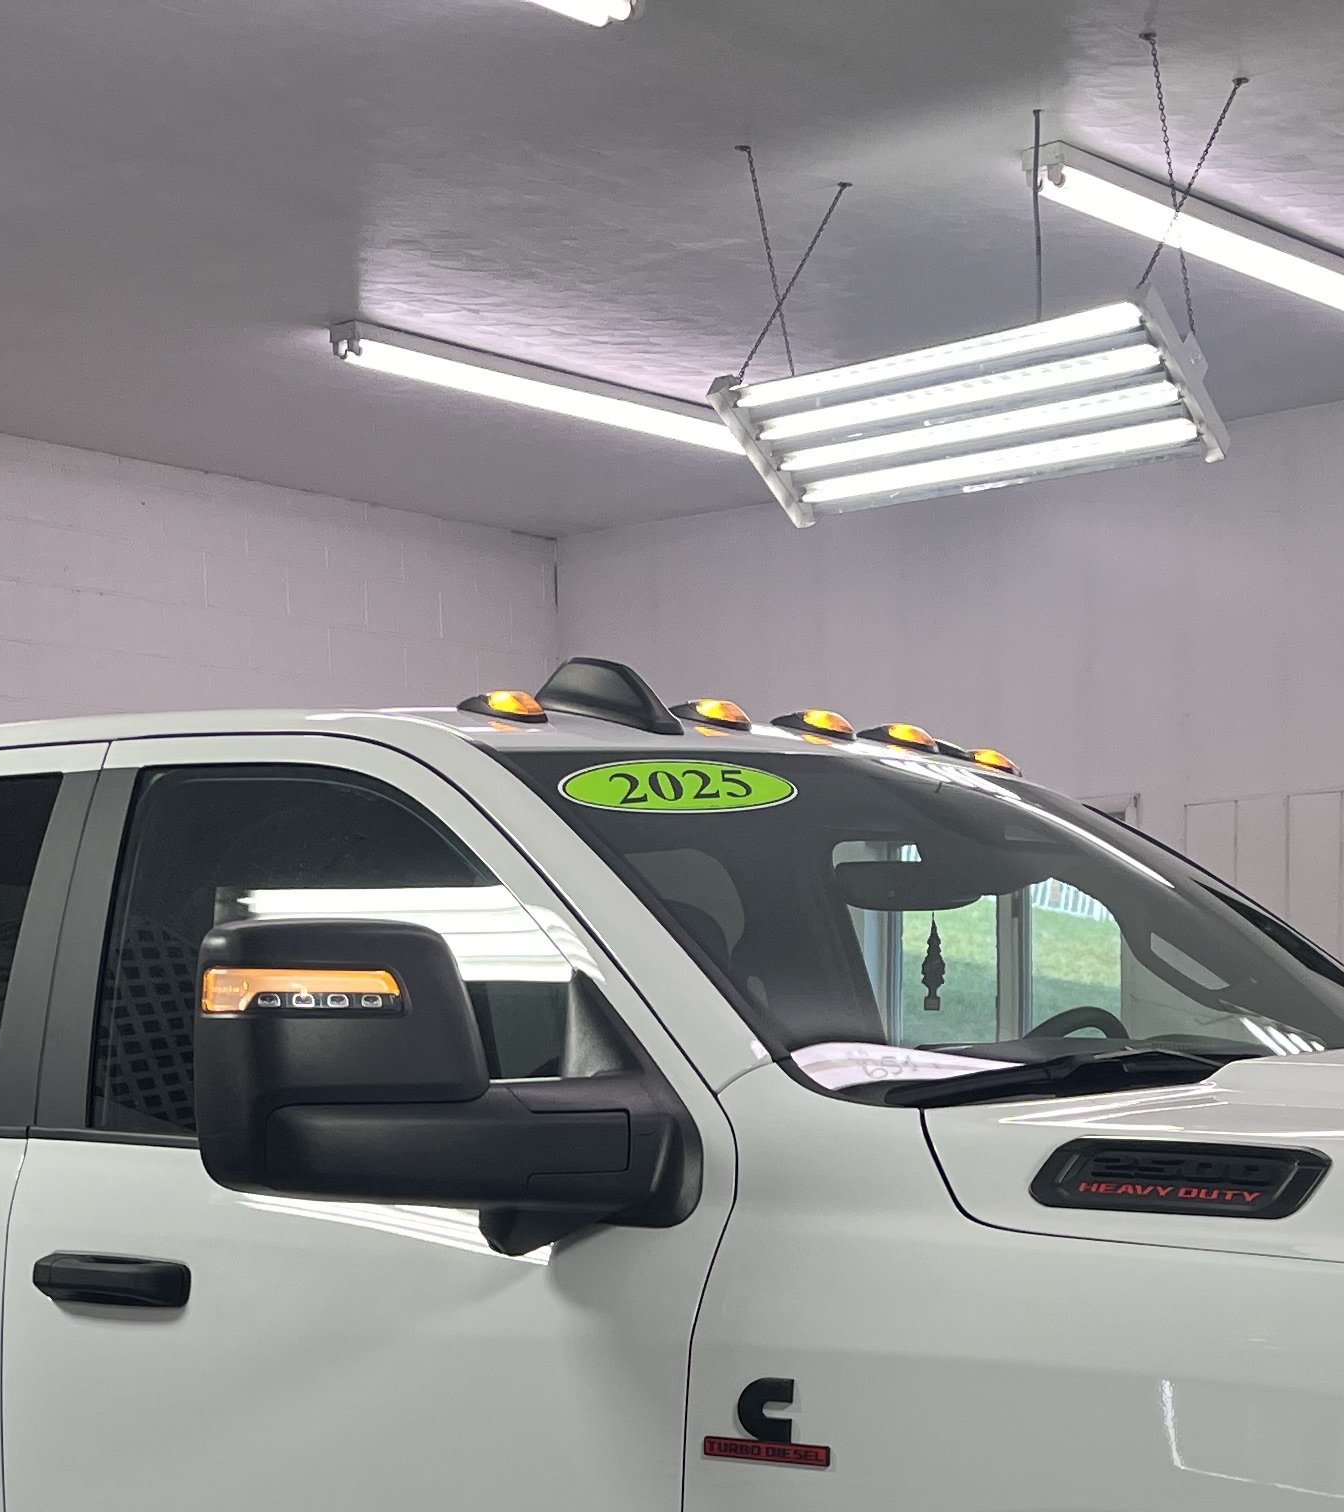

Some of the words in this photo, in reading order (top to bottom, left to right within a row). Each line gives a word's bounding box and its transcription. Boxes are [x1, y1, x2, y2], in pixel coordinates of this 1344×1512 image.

[608, 769, 754, 805] 2025
[1078, 1181, 1175, 1198] HEAVY
[1178, 1187, 1261, 1203] DUTY
[707, 1439, 761, 1457] TURBO
[765, 1445, 825, 1463] DIESEL
